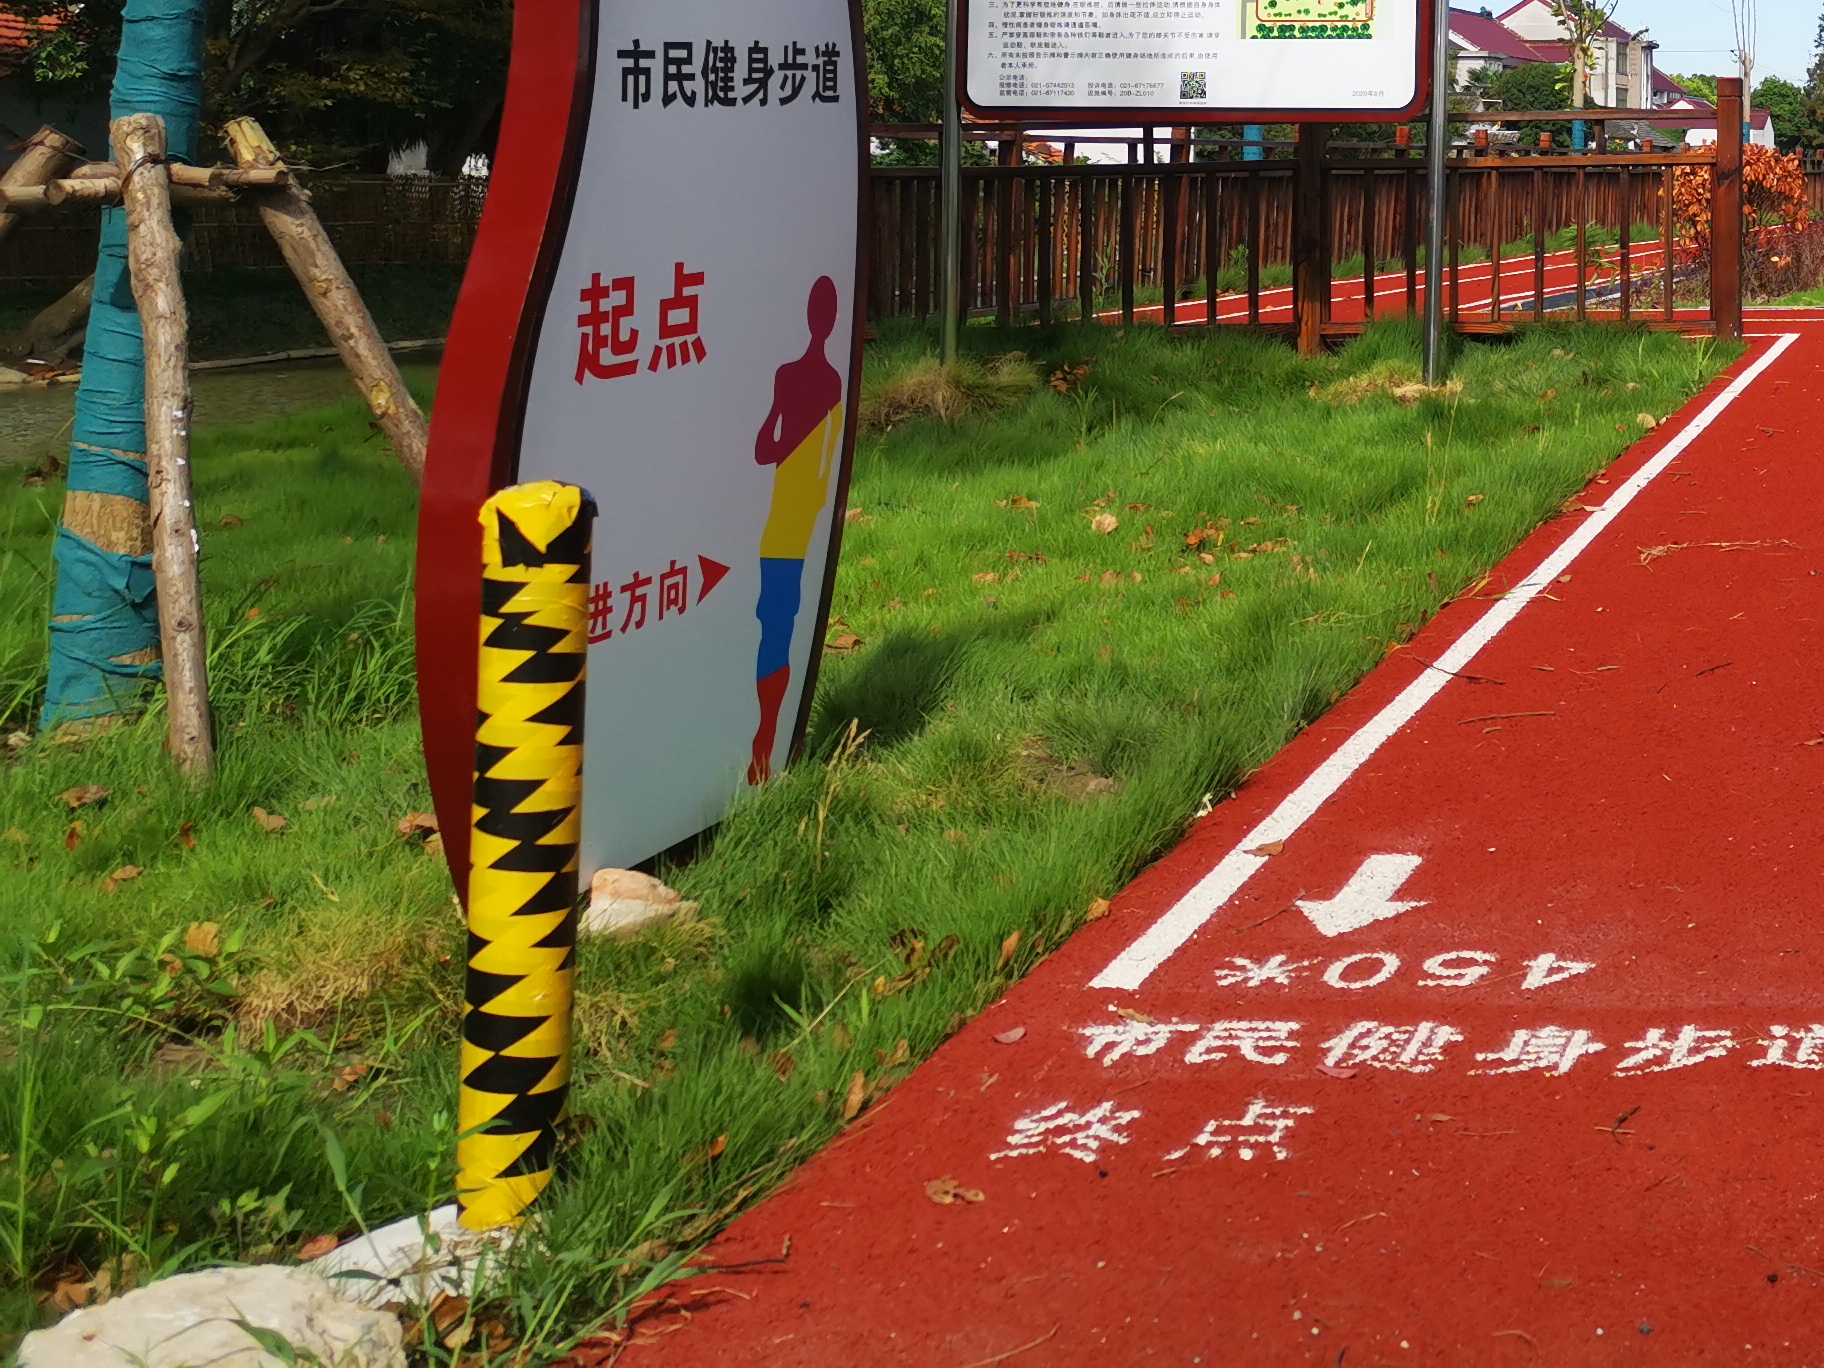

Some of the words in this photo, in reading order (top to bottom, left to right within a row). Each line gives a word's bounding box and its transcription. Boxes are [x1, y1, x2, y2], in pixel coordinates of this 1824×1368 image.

[616, 38, 842, 109] 市民健身步道
[573, 261, 709, 385] 起点
[988, 1099, 1316, 1163] 终点
